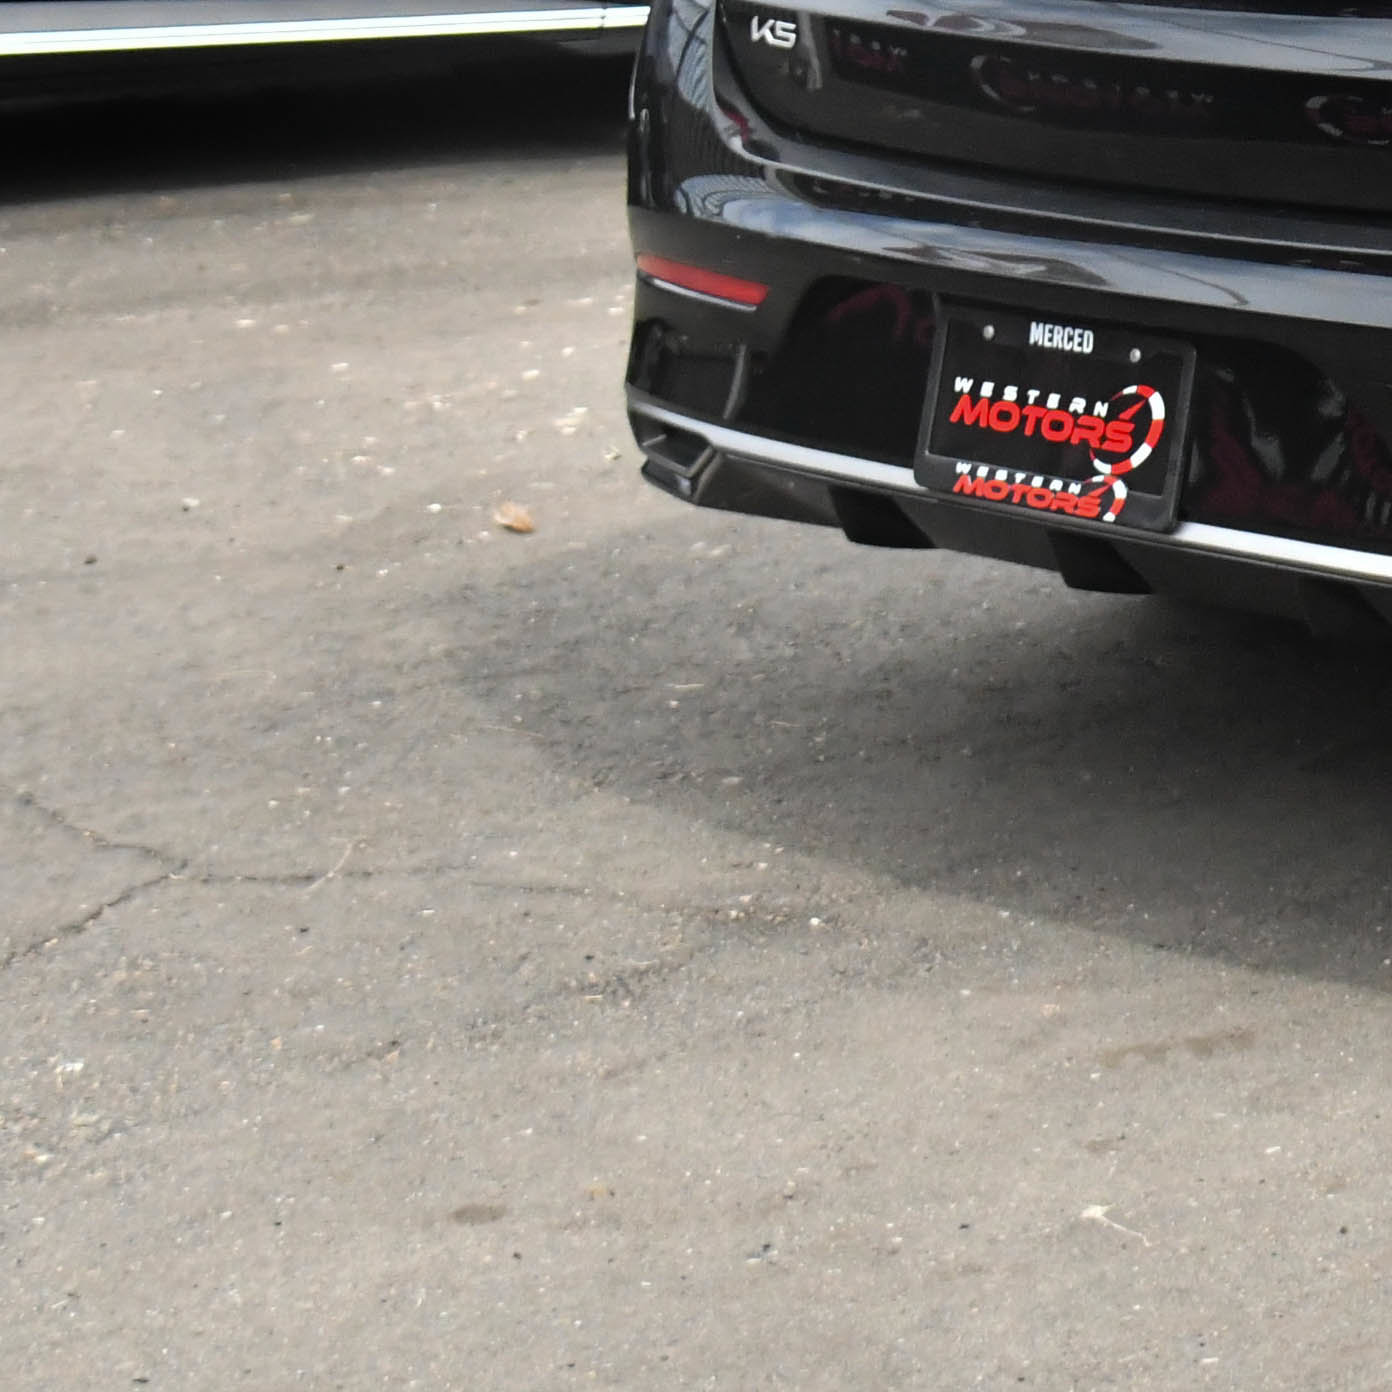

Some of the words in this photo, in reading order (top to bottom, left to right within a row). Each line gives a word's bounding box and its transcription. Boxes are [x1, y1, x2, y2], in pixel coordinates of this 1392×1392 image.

[751, 15, 797, 49] K5
[1028, 321, 1095, 355] MERCED
[954, 375, 1109, 418] WESTERN
[949, 393, 1136, 454] MOTORS
[952, 474, 1102, 519] MOTORS
[955, 461, 1082, 495] WESTERN
